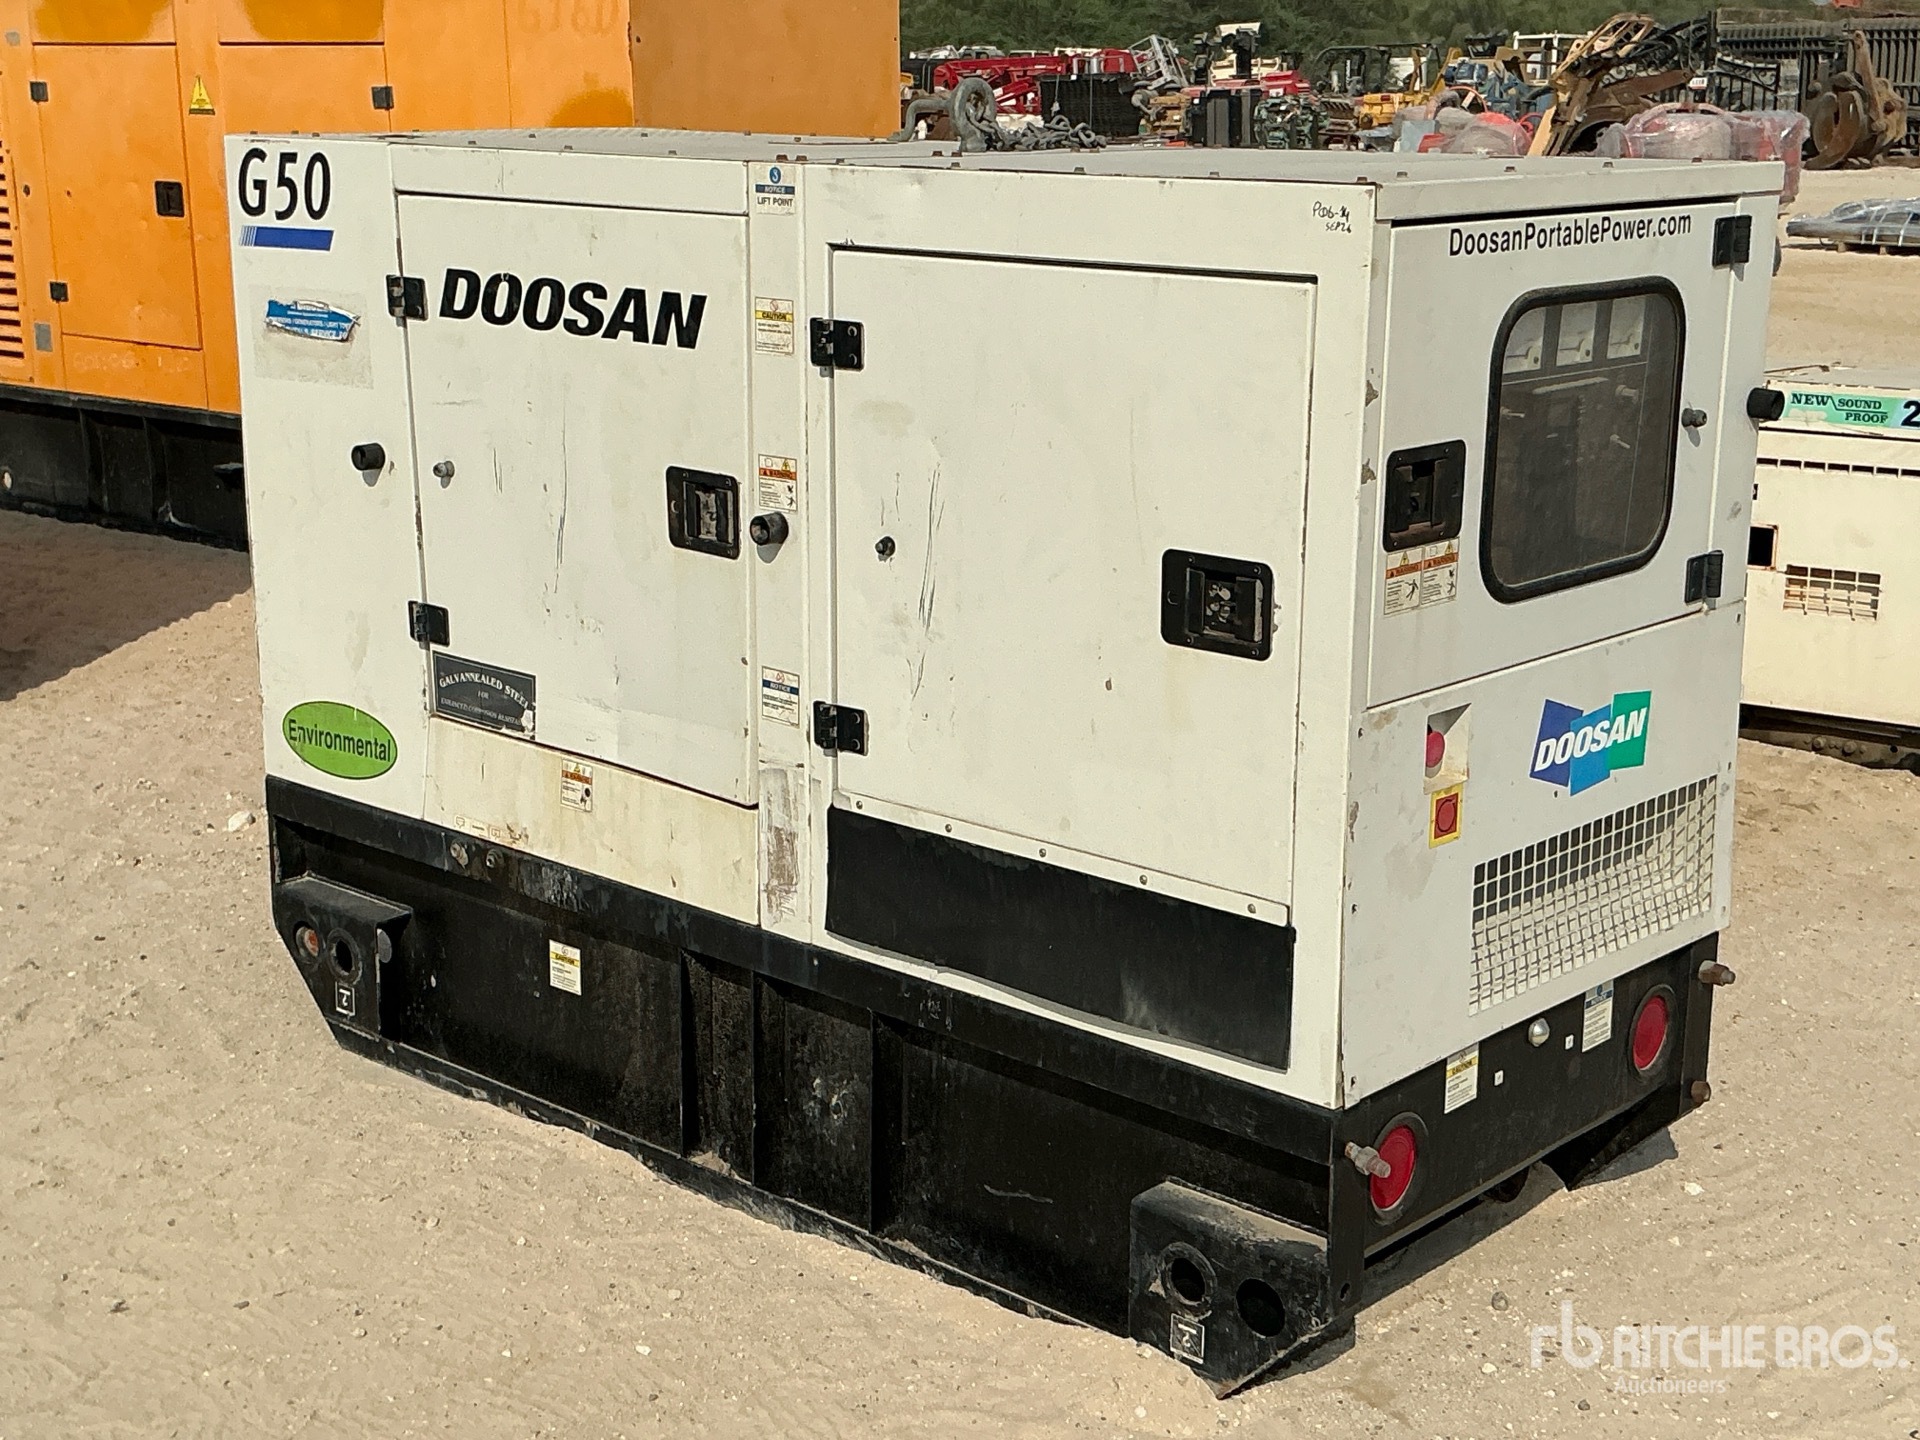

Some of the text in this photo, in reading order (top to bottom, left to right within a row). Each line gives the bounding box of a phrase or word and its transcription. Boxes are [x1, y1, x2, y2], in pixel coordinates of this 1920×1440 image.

[238, 147, 331, 221] G50
[757, 196, 794, 207] LIFT POINT
[1449, 213, 1692, 257] DoosanPortablePower.com
[439, 268, 708, 350] DOOSAN
[1791, 392, 1831, 407] NEW
[1837, 398, 1883, 410] SOUND
[1844, 411, 1888, 424] PROOF
[439, 671, 503, 690] GALVANNEALED
[288, 717, 392, 763] Environmental
[1533, 706, 1648, 773] DOOSAN
